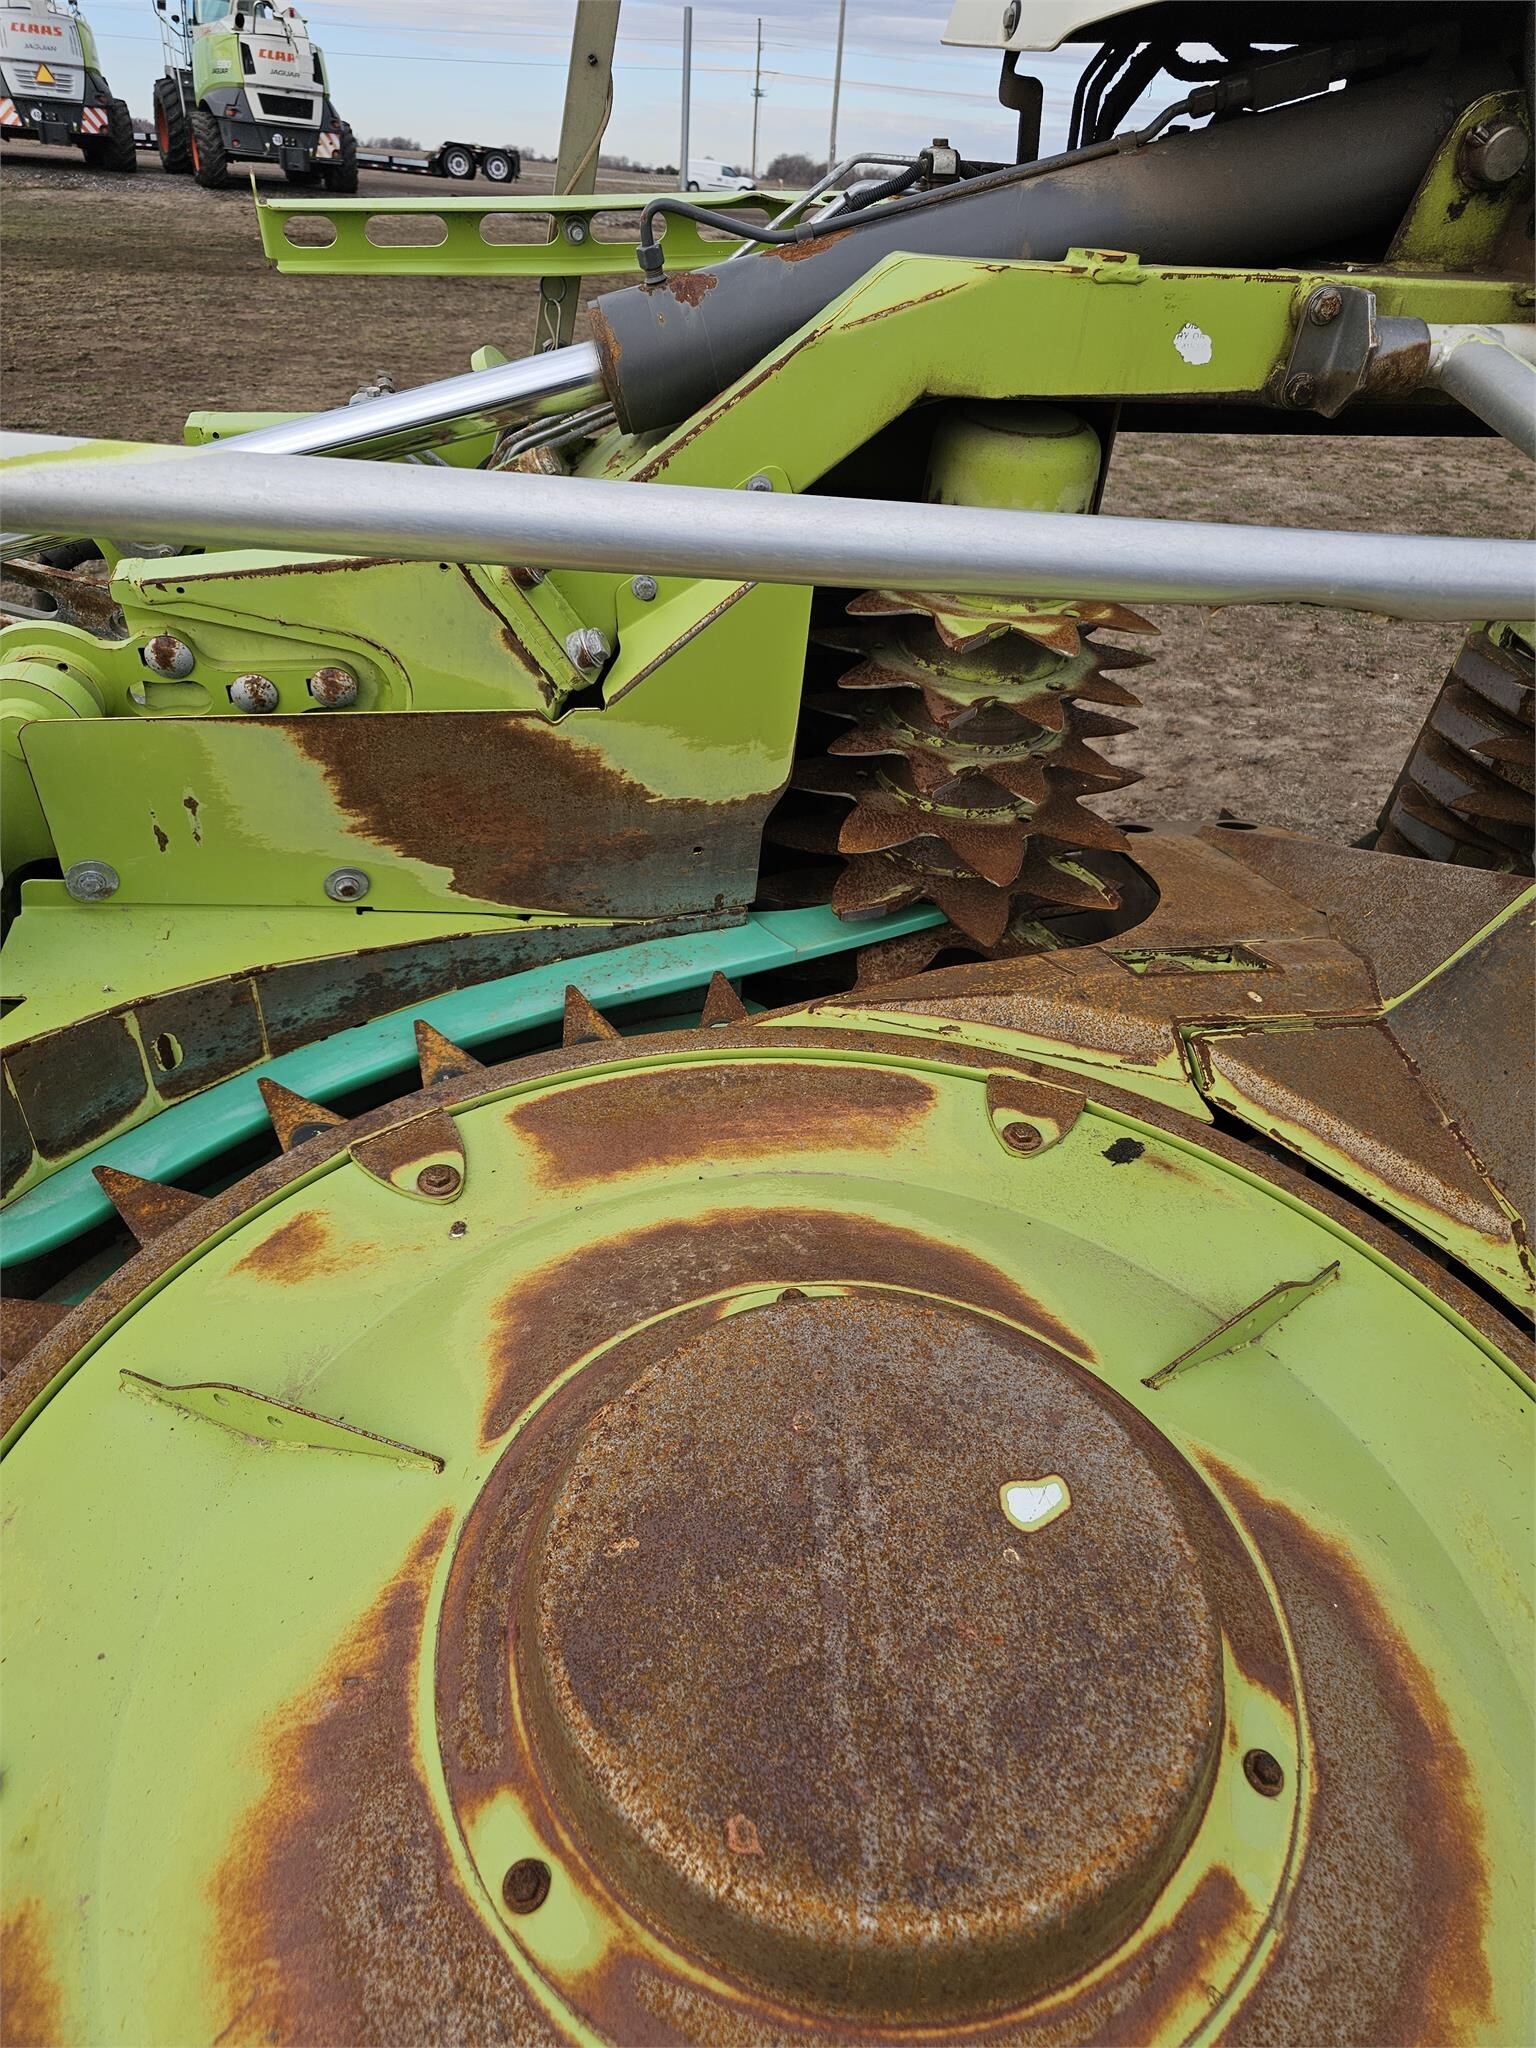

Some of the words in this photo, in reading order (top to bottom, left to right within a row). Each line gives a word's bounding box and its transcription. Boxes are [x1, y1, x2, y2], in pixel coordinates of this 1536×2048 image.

[10, 21, 63, 37] CLAAS
[258, 48, 296, 64] CLAA
[269, 68, 301, 79] JAGUAR
